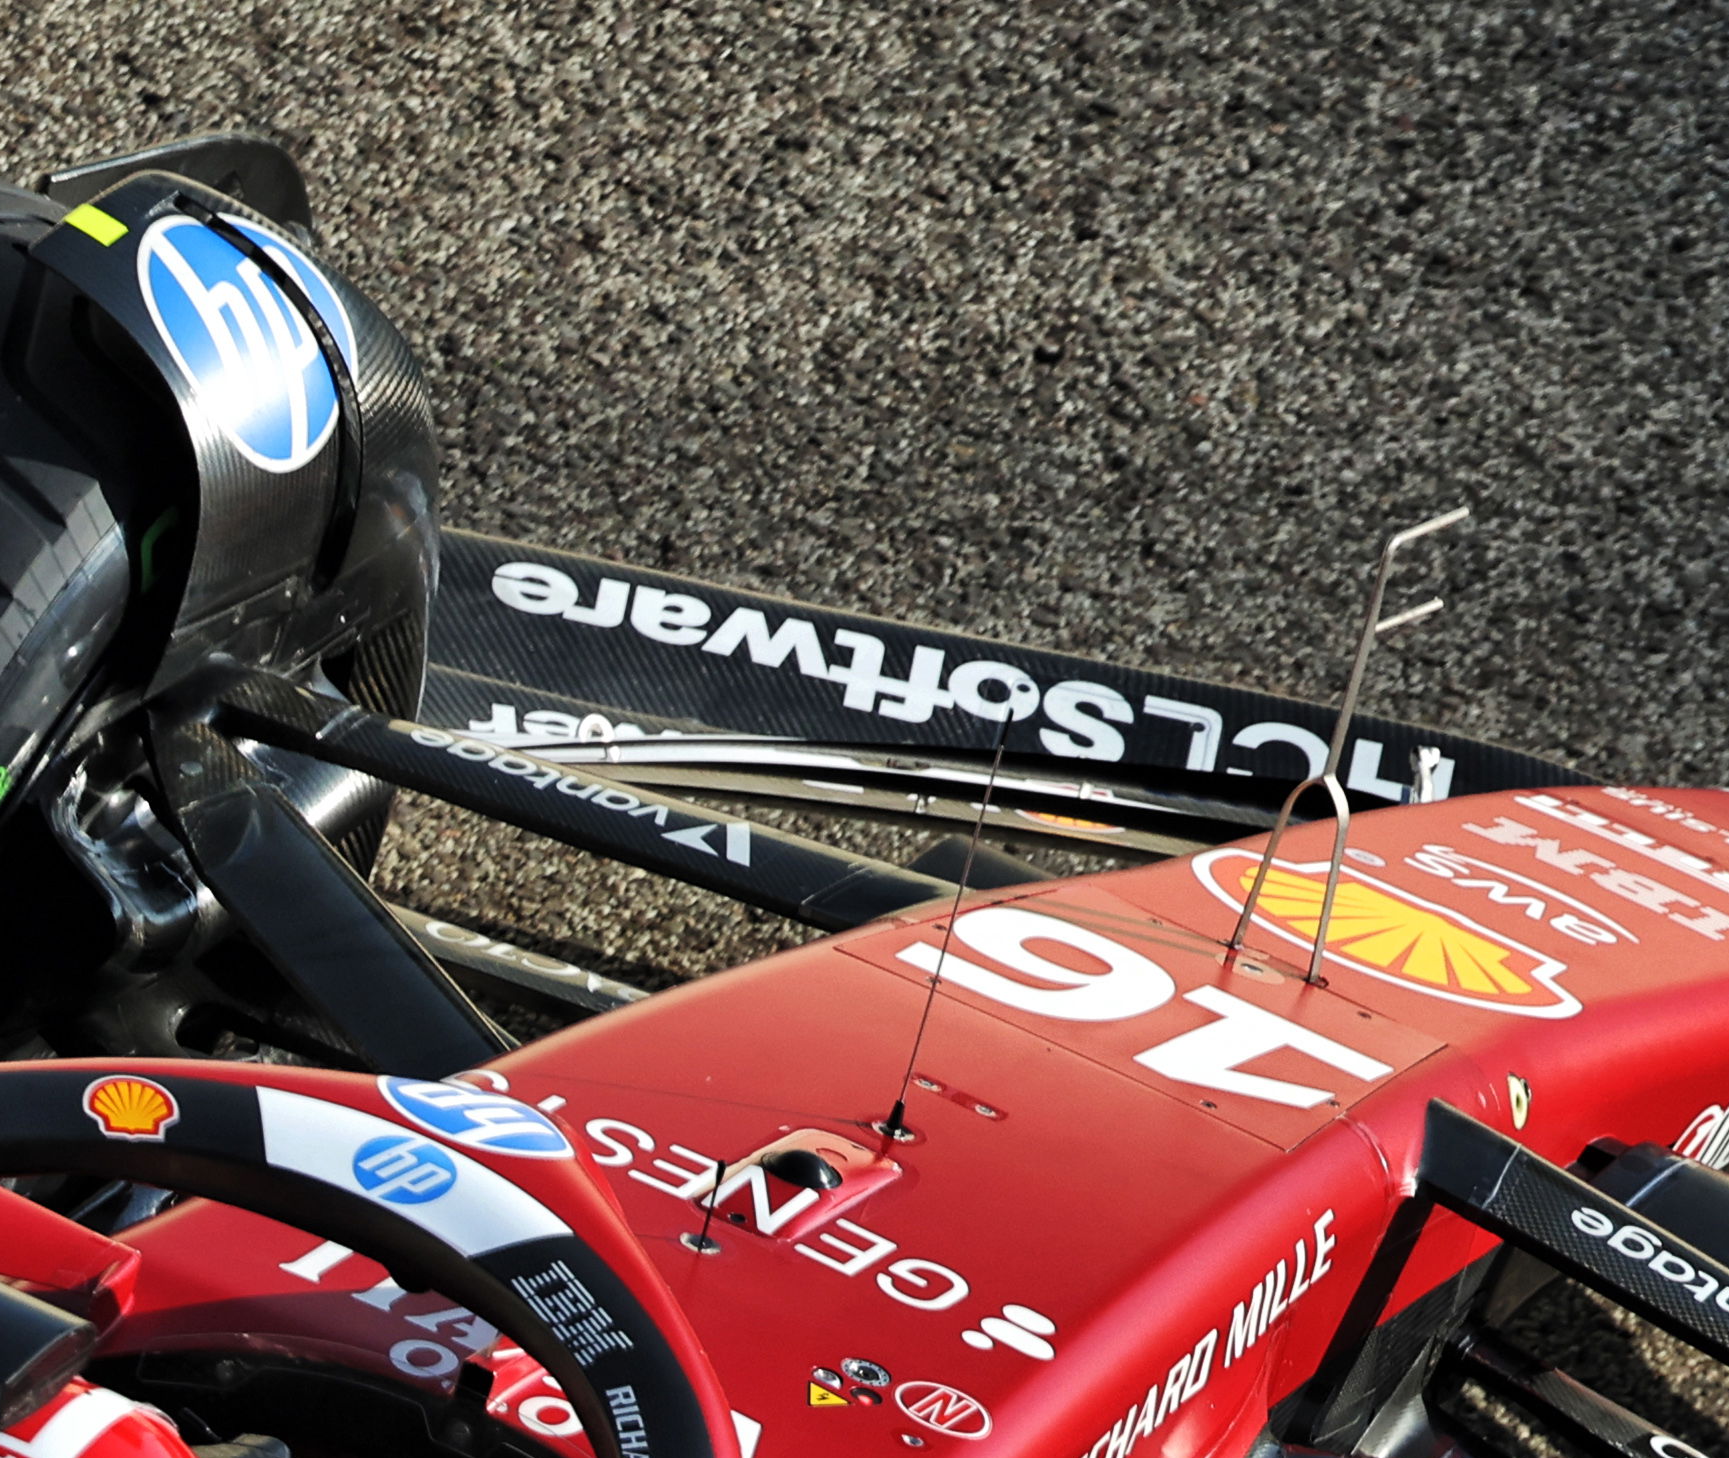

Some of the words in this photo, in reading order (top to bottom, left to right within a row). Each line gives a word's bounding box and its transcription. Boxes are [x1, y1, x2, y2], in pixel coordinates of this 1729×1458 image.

[140, 220, 336, 468] hp
[492, 562, 1455, 803] HCLSoftware
[411, 727, 669, 826] vantage
[1404, 843, 1620, 946] aws
[894, 907, 1395, 1108] 16
[384, 1076, 566, 1154] hp
[355, 1136, 453, 1203] hp
[511, 1260, 633, 1366] IBM
[1224, 1209, 1338, 1369] MILLE
